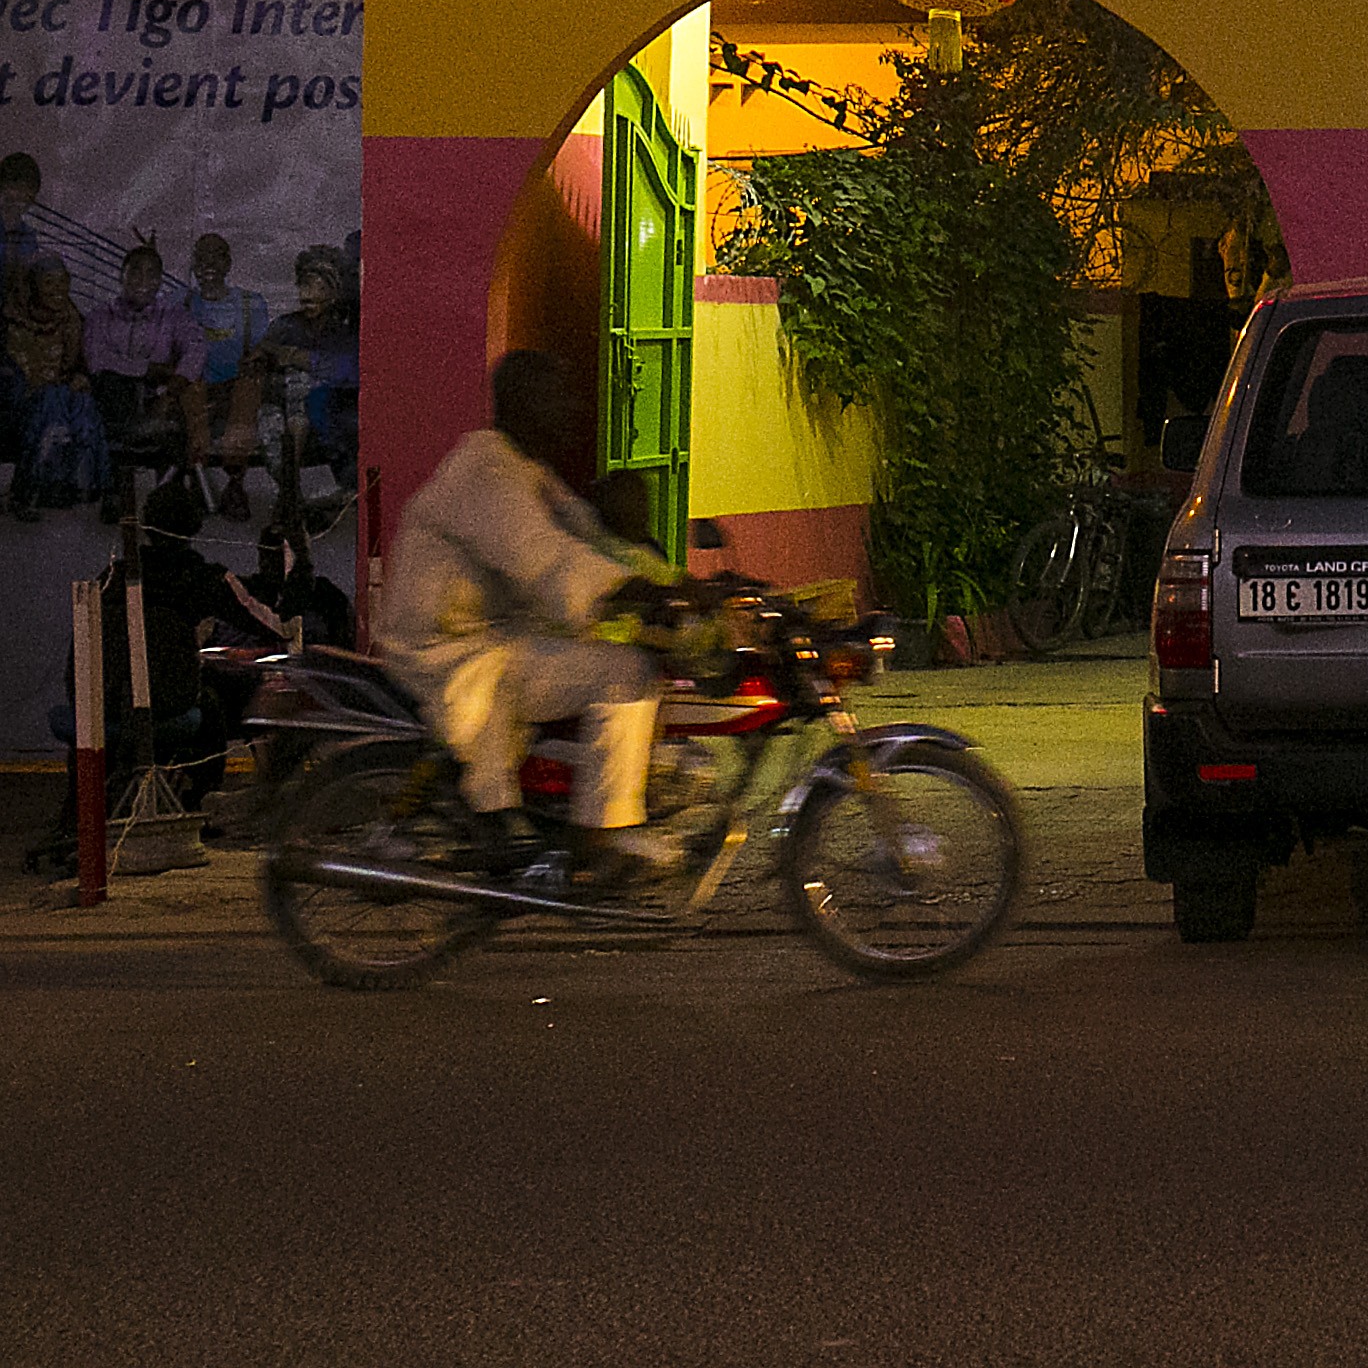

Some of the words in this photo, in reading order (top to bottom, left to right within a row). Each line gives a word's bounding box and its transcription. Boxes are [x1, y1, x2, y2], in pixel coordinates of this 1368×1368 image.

[33, 55, 247, 108] devient
[261, 72, 361, 123] pos
[1264, 564, 1300, 572] TOYOTA
[1305, 561, 1347, 573] LAND
[1249, 580, 1277, 612] 18
